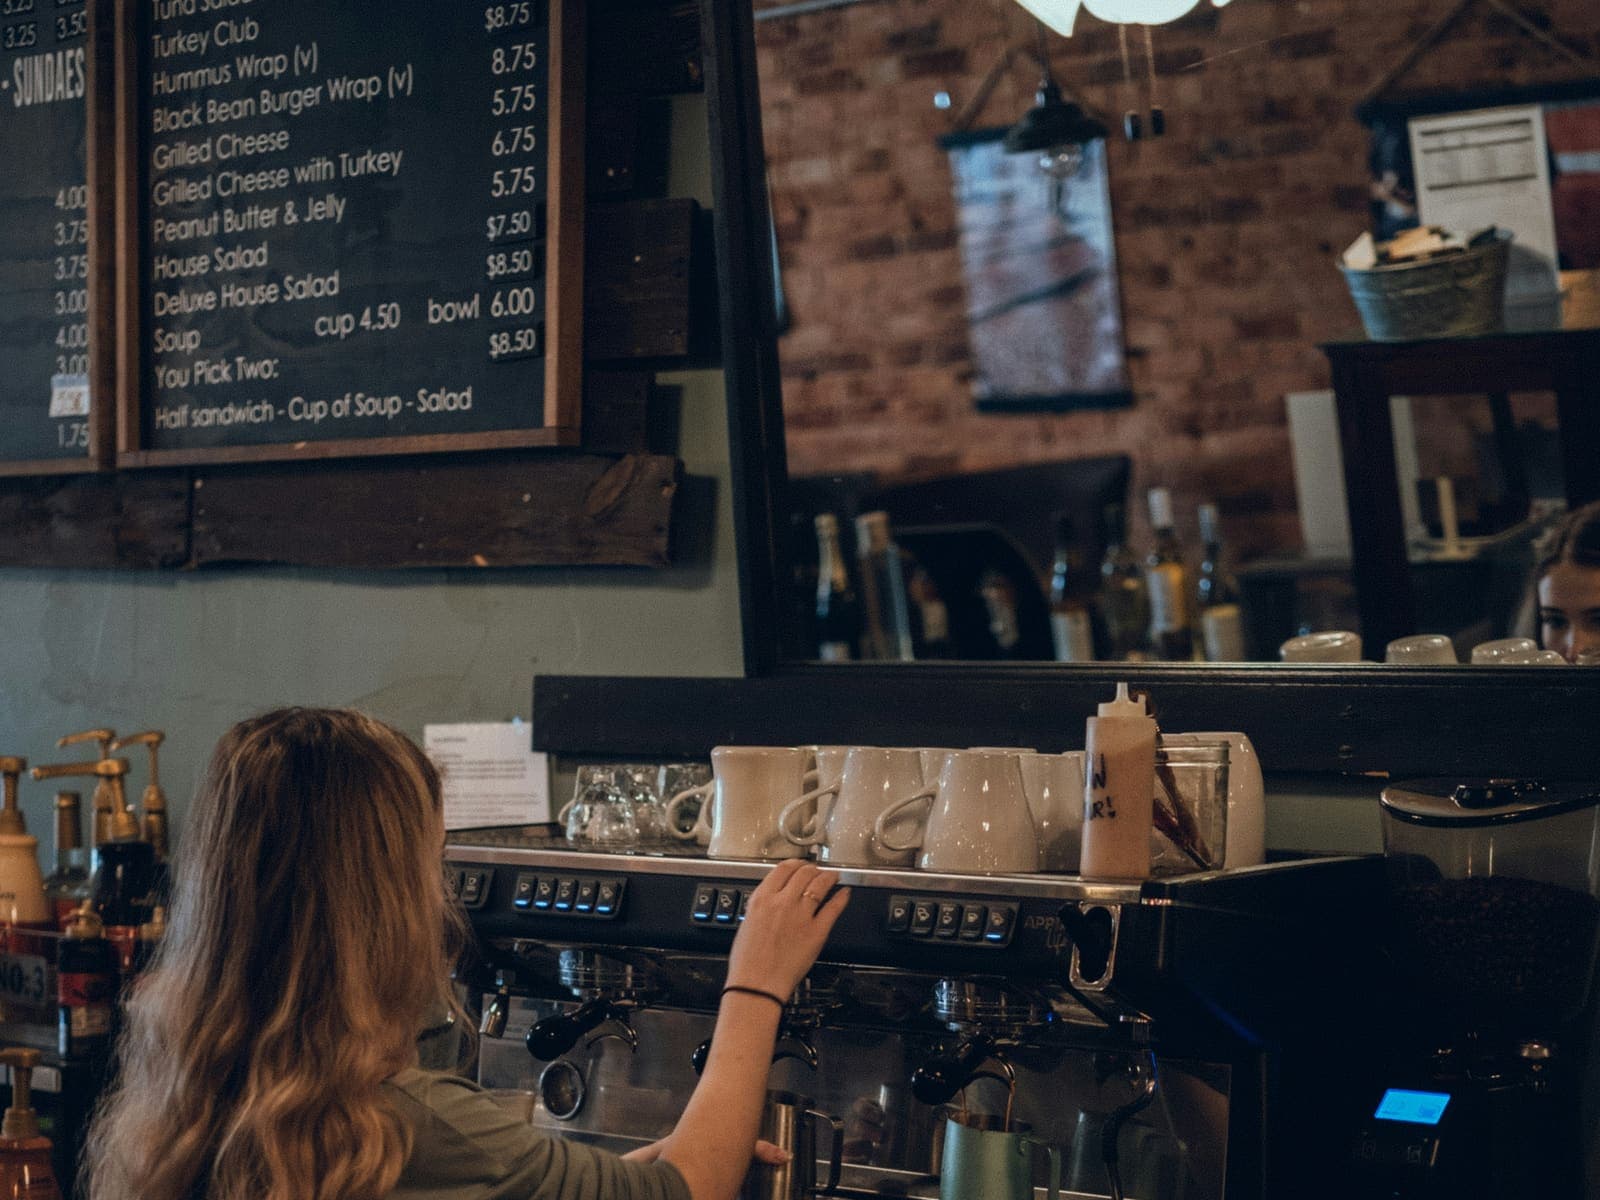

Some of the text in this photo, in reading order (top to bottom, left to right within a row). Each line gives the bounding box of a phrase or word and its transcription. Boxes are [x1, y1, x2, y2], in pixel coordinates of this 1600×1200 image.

[6, 24, 36, 48] 3.25
[152, 17, 259, 58] Turkey Club
[153, 2, 530, 95] Hummus Wrap (v) $8.75
[13, 47, 85, 107] SUNDAES
[153, 43, 536, 133] Black Bean Burger Wrap (v) 8.75
[153, 84, 536, 170] Grilled Cheese 5.75
[153, 125, 536, 206] Grilled Cheese with Turkey 6.75
[55, 185, 88, 210] 4.00
[154, 166, 536, 243] Peanut Butter & Jelly 5.75
[54, 220, 88, 246] 3.75
[154, 210, 532, 280] House Salad $7.50
[54, 254, 89, 280] 3.75
[154, 250, 533, 317] Deluxe House Salad $8.50
[55, 289, 88, 315] 3.00
[154, 287, 535, 355] Soup cup 4.50 bowl 6.00
[55, 323, 89, 348] 4.00
[155, 329, 536, 389] You Pick Two: $8.50
[155, 404, 190, 429] Half
[191, 399, 275, 428] sandwich
[288, 396, 329, 424] Cup
[331, 392, 350, 418] of
[354, 393, 401, 420] Soup
[416, 385, 473, 414] Salad
